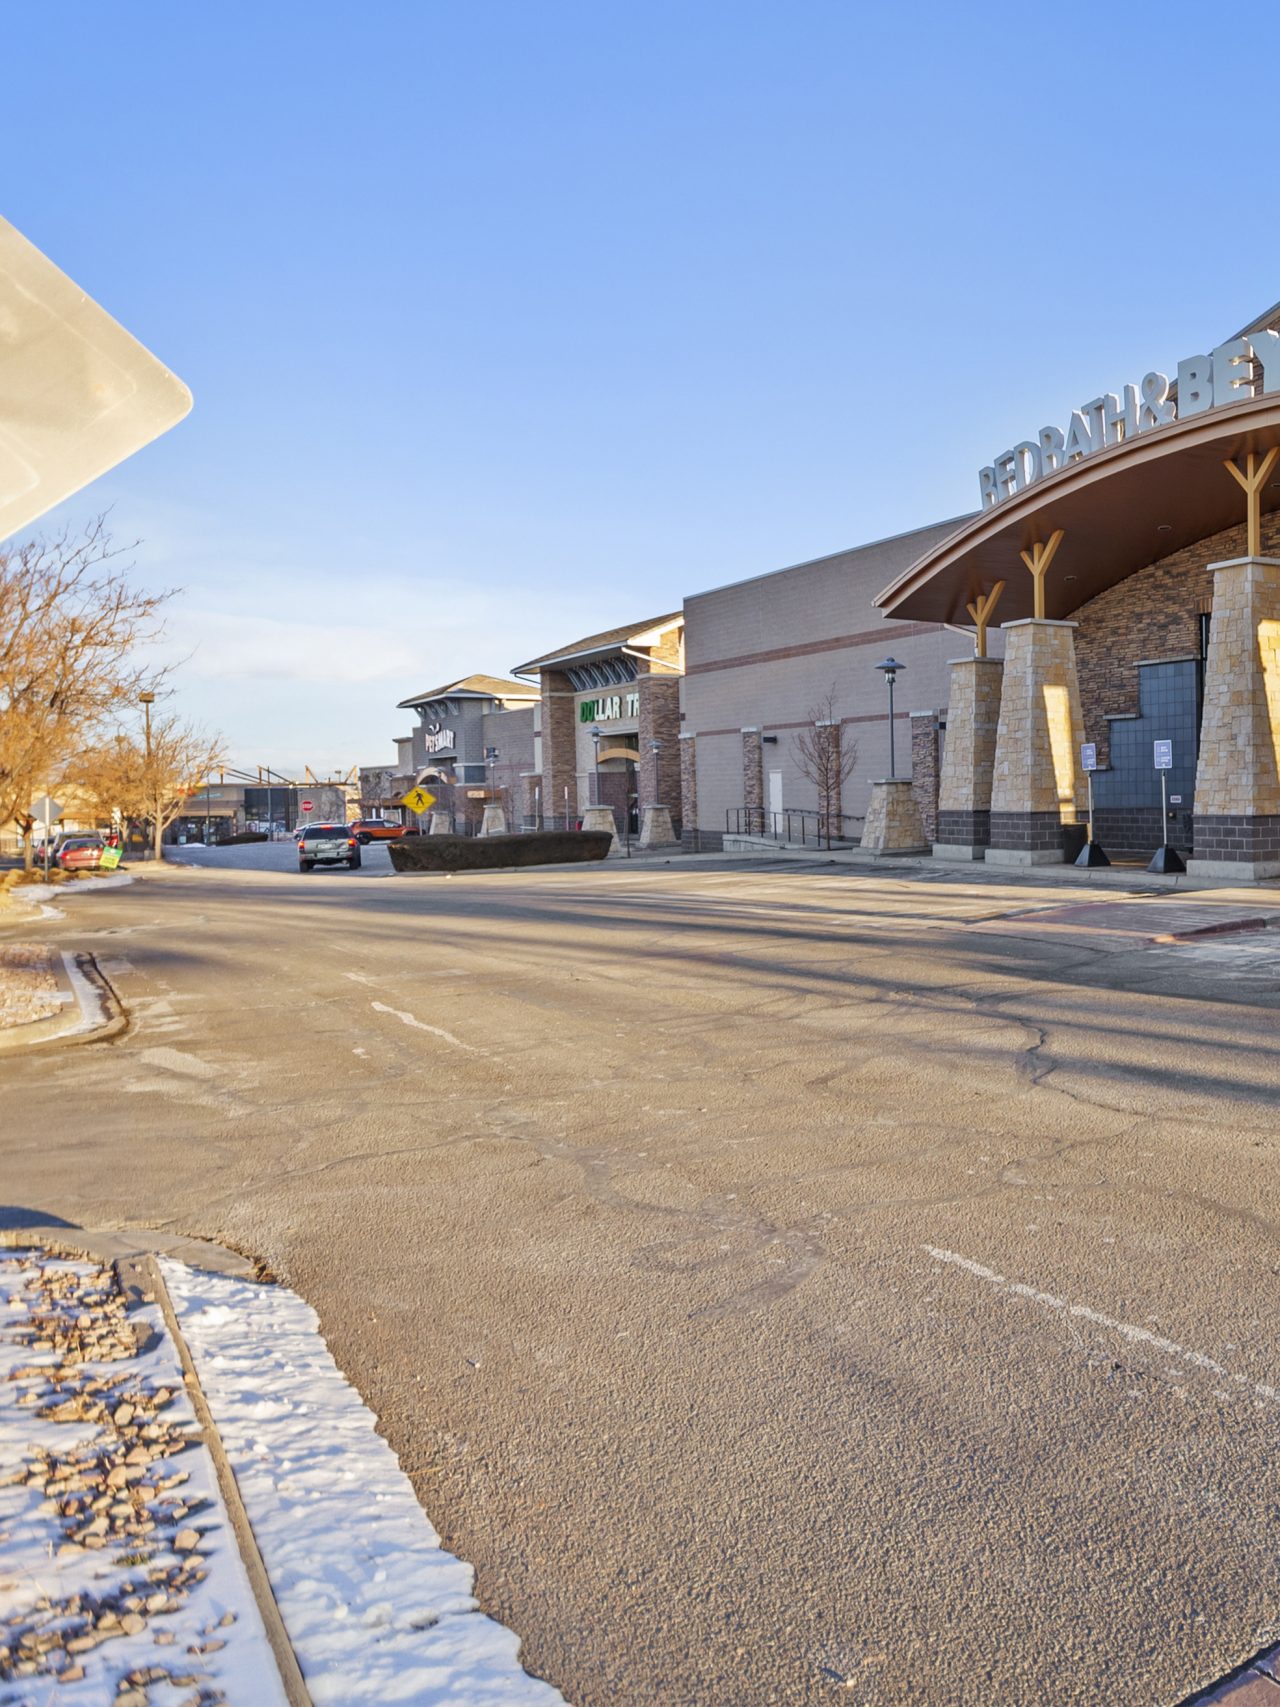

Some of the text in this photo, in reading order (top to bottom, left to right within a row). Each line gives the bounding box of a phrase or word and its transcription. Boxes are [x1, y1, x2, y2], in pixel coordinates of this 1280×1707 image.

[978, 440, 1043, 511] BED
[1038, 384, 1140, 475] BATH
[1139, 372, 1176, 432] &
[580, 696, 621, 723] DOLLAR
